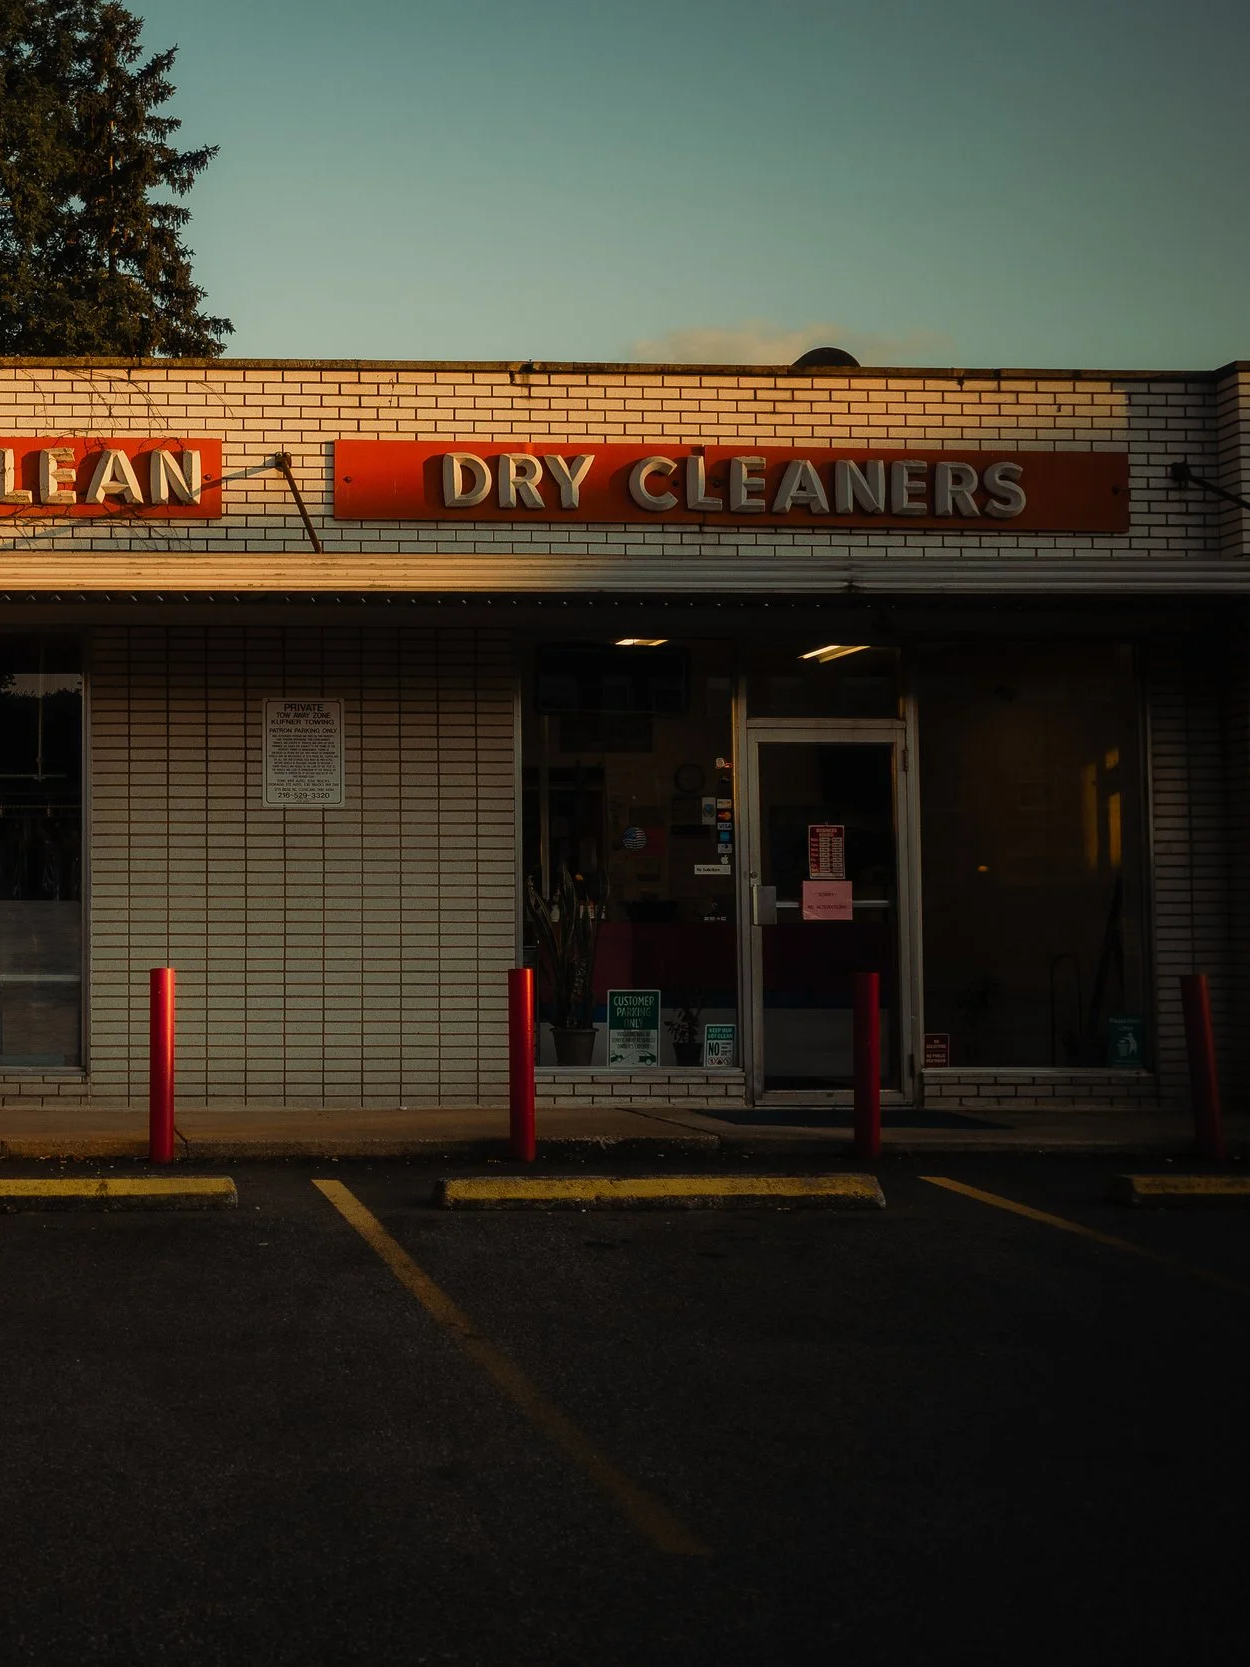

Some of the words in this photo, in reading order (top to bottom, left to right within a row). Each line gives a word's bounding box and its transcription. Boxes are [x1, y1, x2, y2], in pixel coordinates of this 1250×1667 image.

[441, 451, 595, 509] DRY
[628, 454, 1028, 518] CLEANERS
[284, 703, 324, 712] PRIVATE
[613, 996, 655, 1006] CUSTOMER
[616, 1007, 652, 1017] PARKING
[623, 1018, 644, 1028] ONLY
[709, 1042, 720, 1056] NO
